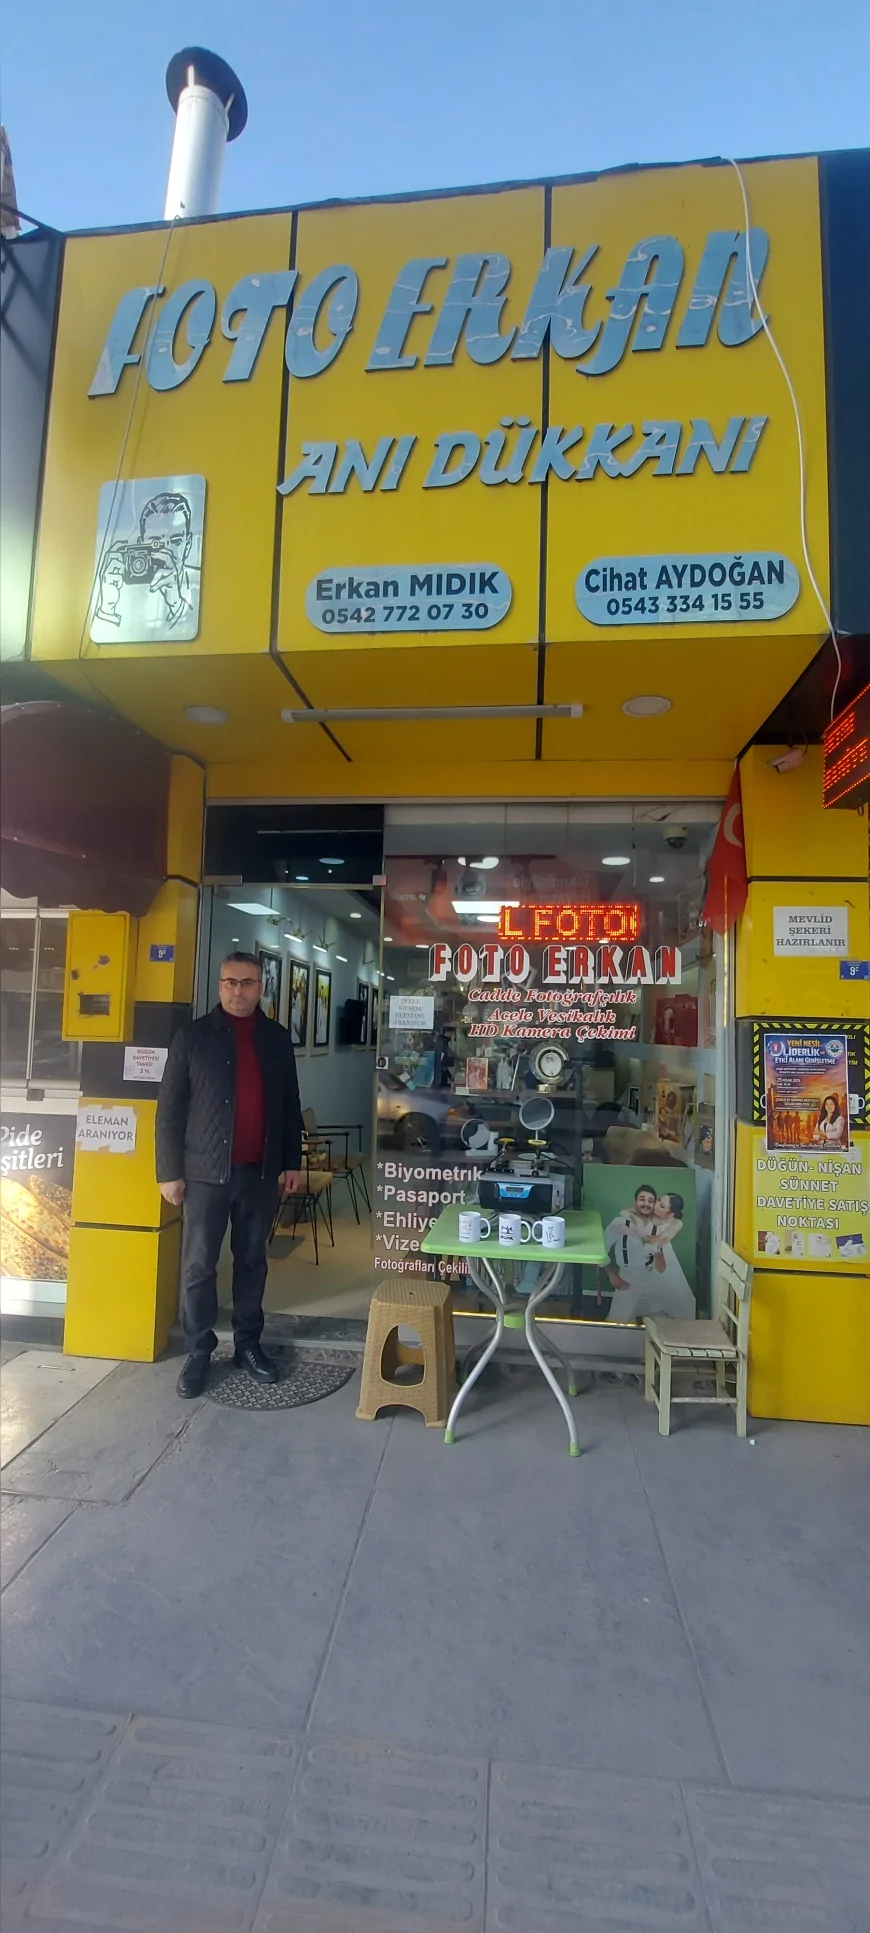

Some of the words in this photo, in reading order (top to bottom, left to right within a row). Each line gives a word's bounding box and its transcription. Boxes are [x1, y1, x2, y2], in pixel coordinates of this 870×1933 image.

[87, 264, 359, 400] FOTO
[364, 227, 771, 376] ERKAN
[276, 436, 418, 496] ANI
[422, 416, 769, 488] DÜKKANI
[584, 567, 648, 593] Cihat
[655, 556, 785, 589] AYDOĞAN
[316, 577, 399, 601] Erkan
[409, 571, 500, 597] MIDIK
[606, 596, 660, 616] 0543
[666, 594, 705, 613] 334
[711, 593, 732, 611] 15
[739, 592, 764, 609] 55
[322, 607, 376, 625] 0542
[383, 605, 420, 622] 772
[427, 604, 454, 621] 07
[461, 603, 489, 620] 30
[788, 914, 833, 923] MEVLİD
[788, 926, 832, 936] ŞEKERİ
[776, 938, 846, 947] HAZIRLANIR
[428, 943, 530, 983] FOTO
[542, 945, 682, 985] ERKAN
[468, 988, 521, 1002] Cadde
[525, 988, 637, 1005] Fotoğrafçılık
[488, 1007, 534, 1022] Acele
[538, 1008, 616, 1023] Vesikalık
[468, 1023, 499, 1037] HD
[501, 1024, 572, 1038] Kamera
[574, 1025, 636, 1042] Çekimi
[86, 1115, 129, 1126] ELEMAN
[78, 1129, 133, 1141] ARANIYOR
[0, 1147, 64, 1176] şitleri
[818, 1160, 862, 1176] NİŞAN
[780, 1178, 839, 1192] SÜNNET
[757, 1195, 825, 1210] DAVETİYE
[828, 1200, 869, 1215] SATIŞ
[375, 1210, 438, 1232] Ehliye
[777, 1215, 839, 1229] NOKTASI
[374, 1256, 435, 1273] Fotoğrafları
[438, 1260, 471, 1276] Çekili
